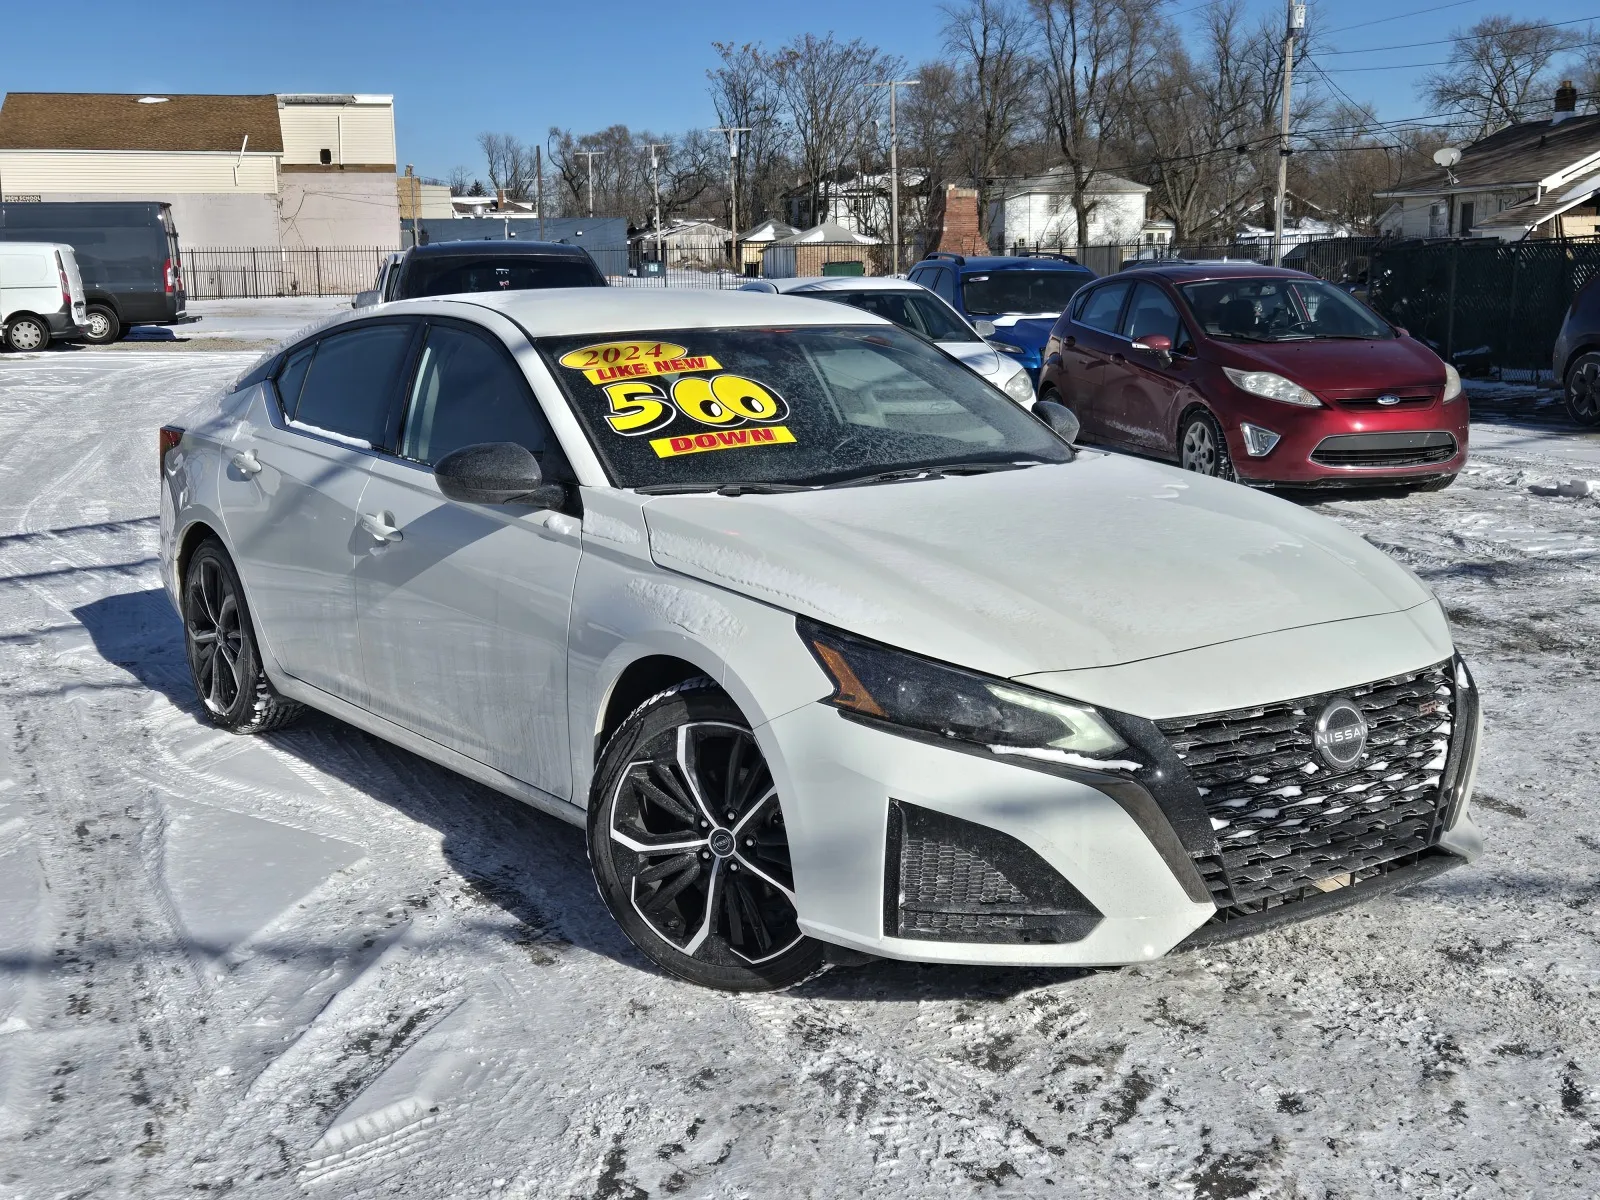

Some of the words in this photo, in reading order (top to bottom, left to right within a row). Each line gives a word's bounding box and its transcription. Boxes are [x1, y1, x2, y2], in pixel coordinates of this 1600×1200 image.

[583, 343, 663, 367] 2024
[596, 362, 650, 381] LIKE
[656, 356, 708, 373] NEW
[602, 374, 790, 437] 500
[669, 428, 778, 454] DOWN
[1317, 725, 1368, 745] NISSAN
